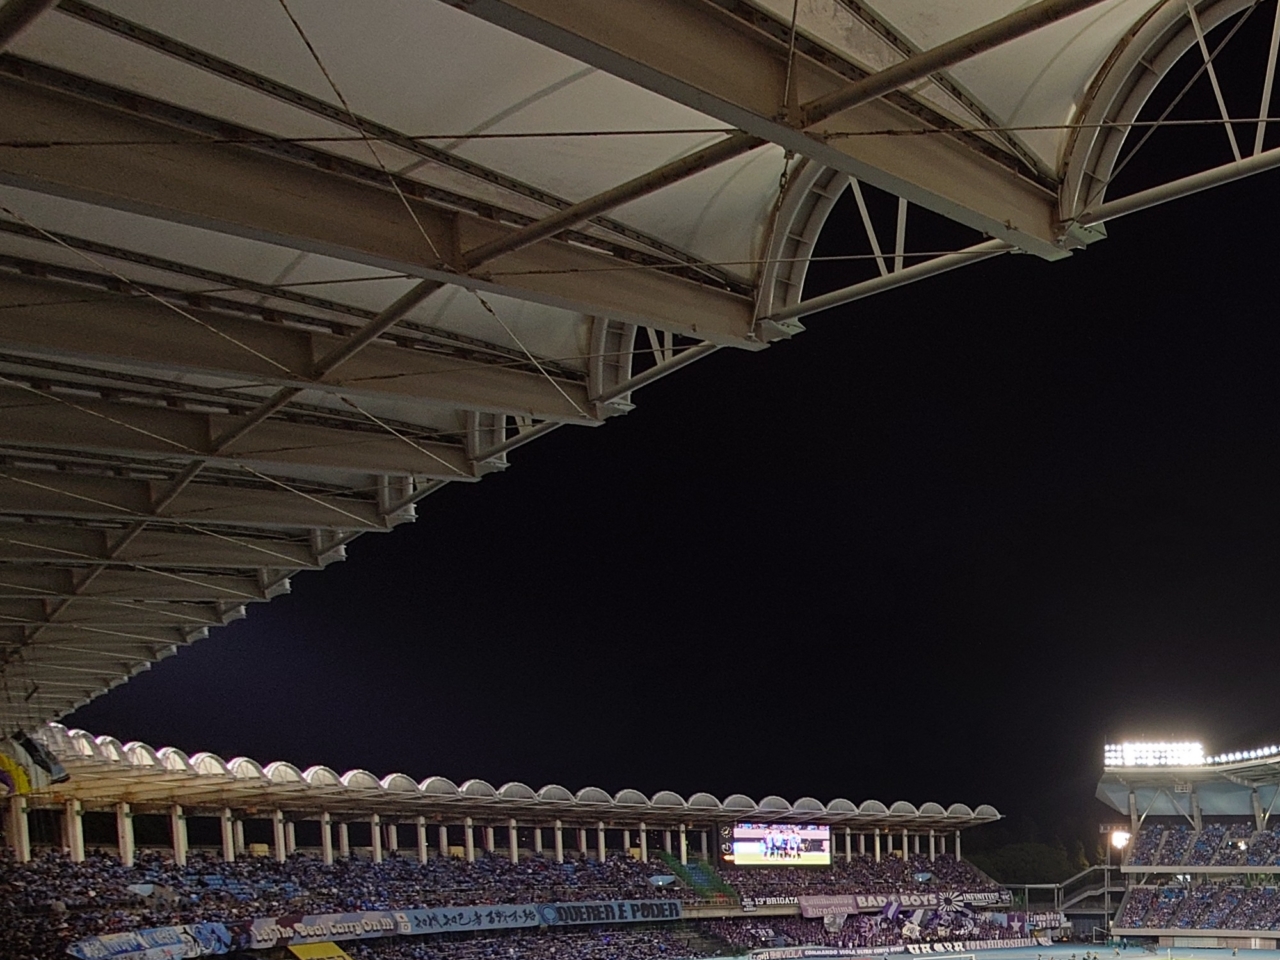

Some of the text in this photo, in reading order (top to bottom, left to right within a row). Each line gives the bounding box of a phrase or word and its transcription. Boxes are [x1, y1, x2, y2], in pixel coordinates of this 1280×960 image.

[857, 894, 937, 907] BAD BOYS
[557, 904, 614, 923] QUERER
[631, 902, 680, 918] PODER
[271, 926, 294, 939] The
[294, 923, 326, 938] Beat
[330, 921, 361, 935] Carry
[363, 919, 380, 931] On
